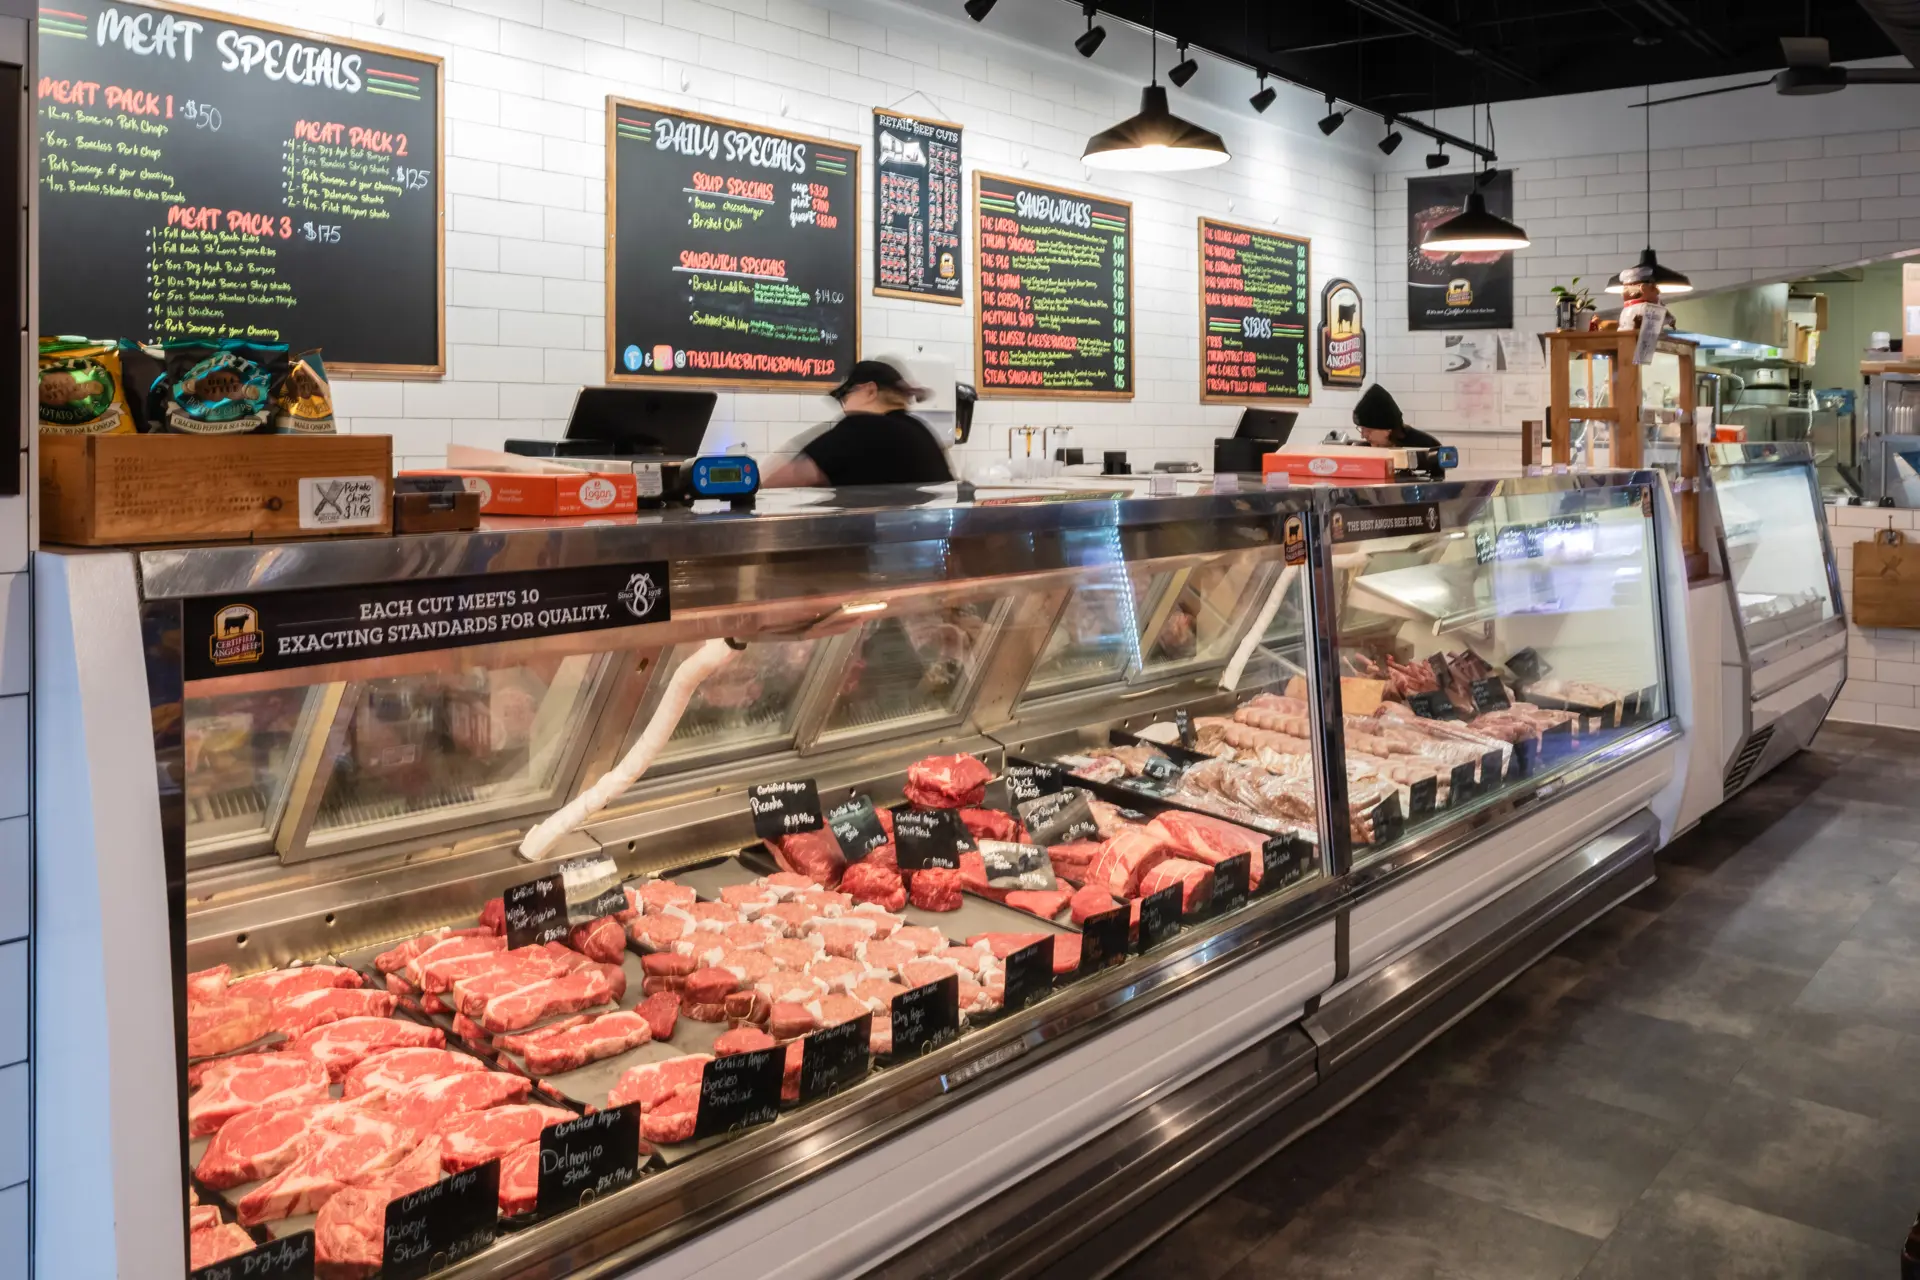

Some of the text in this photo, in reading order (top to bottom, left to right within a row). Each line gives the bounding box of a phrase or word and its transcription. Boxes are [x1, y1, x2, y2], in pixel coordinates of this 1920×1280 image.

[97, 8, 362, 93] MEAT SPECIALS
[38, 76, 100, 105] MEAT
[104, 86, 160, 116] PACK
[165, 95, 173, 119] 1
[117, 115, 139, 131] Pork
[141, 120, 168, 138] Chops
[880, 115, 958, 143] RETAIL BEEF CUTS
[295, 120, 408, 156] MEAT PACK 2
[655, 118, 806, 174] DAILY SPECIALS
[76, 136, 161, 161] Boneless Pork Chops
[48, 154, 69, 171] Pork
[71, 161, 103, 179] Sausage
[108, 163, 117, 175] of
[120, 168, 136, 181] your
[301, 168, 318, 182] Pork
[397, 166, 430, 191] $125
[693, 172, 774, 200] SOUP SPECIALS
[792, 183, 809, 198] cup
[695, 196, 764, 221] bacon cheeseburger
[790, 195, 812, 212] pint
[1016, 191, 1091, 228] SANDWICHES
[168, 205, 341, 244] MEAT PACK 3 $175
[692, 212, 742, 232] Brisket Chili
[789, 209, 816, 229] quart
[980, 215, 994, 231] THE
[164, 227, 178, 238] Full
[201, 230, 218, 245] Baby
[220, 232, 240, 242] Back
[242, 233, 259, 244] Ribs
[1007, 235, 1036, 254] SAUSAGE
[163, 242, 177, 254] Full
[679, 250, 786, 277] SANDWICH SPECIALS
[693, 275, 717, 291] Brisket
[815, 289, 844, 304] $14.00
[982, 290, 995, 306] THE
[1025, 295, 1031, 309] 2
[167, 306, 224, 318] Half Chickens
[982, 310, 1018, 326] MEATBALL
[1018, 312, 1034, 328] SUB
[165, 318, 184, 332] Pork
[229, 325, 244, 337] your
[1243, 316, 1272, 339] SIDES
[984, 330, 998, 345] THE
[999, 330, 1026, 346] CLASSIC
[1027, 332, 1078, 350] CHEESEBURGER
[1329, 337, 1360, 354] CERTIFIED
[1326, 353, 1351, 368] ANGUS
[984, 368, 1007, 384] STEAK
[1008, 369, 1043, 386] SANDWICH
[173, 418, 201, 431] CRACKED
[202, 422, 223, 431] PEPPER
[345, 482, 371, 494] Potato
[583, 485, 612, 501] Logan
[346, 493, 371, 503] Chips
[344, 505, 370, 519] $1.99
[1347, 522, 1360, 532] THE
[1361, 521, 1374, 531] BEST
[1375, 518, 1393, 529] ANGUS
[1409, 516, 1423, 526] EVER.
[648, 588, 661, 597] 1978
[359, 587, 540, 623] EACH CUT MEETS 10
[278, 603, 611, 656] EXACTING STANDARDS FOR QUALITY.
[216, 633, 256, 648] CERTIFIED
[213, 646, 240, 656] ANGUS
[1010, 766, 1052, 779] Certified Angus
[757, 781, 806, 796] Certified Angus
[1007, 777, 1034, 789] Chuck
[1015, 786, 1040, 800] Roast
[749, 795, 783, 815] Picanha
[895, 813, 939, 829] Certified Angus
[1026, 810, 1039, 823] Top
[703, 1074, 738, 1093] Boneless
[555, 1110, 621, 1138] Certified Angus
[540, 1143, 603, 1174] Delmonico
[402, 1170, 478, 1212] Certified Angus
